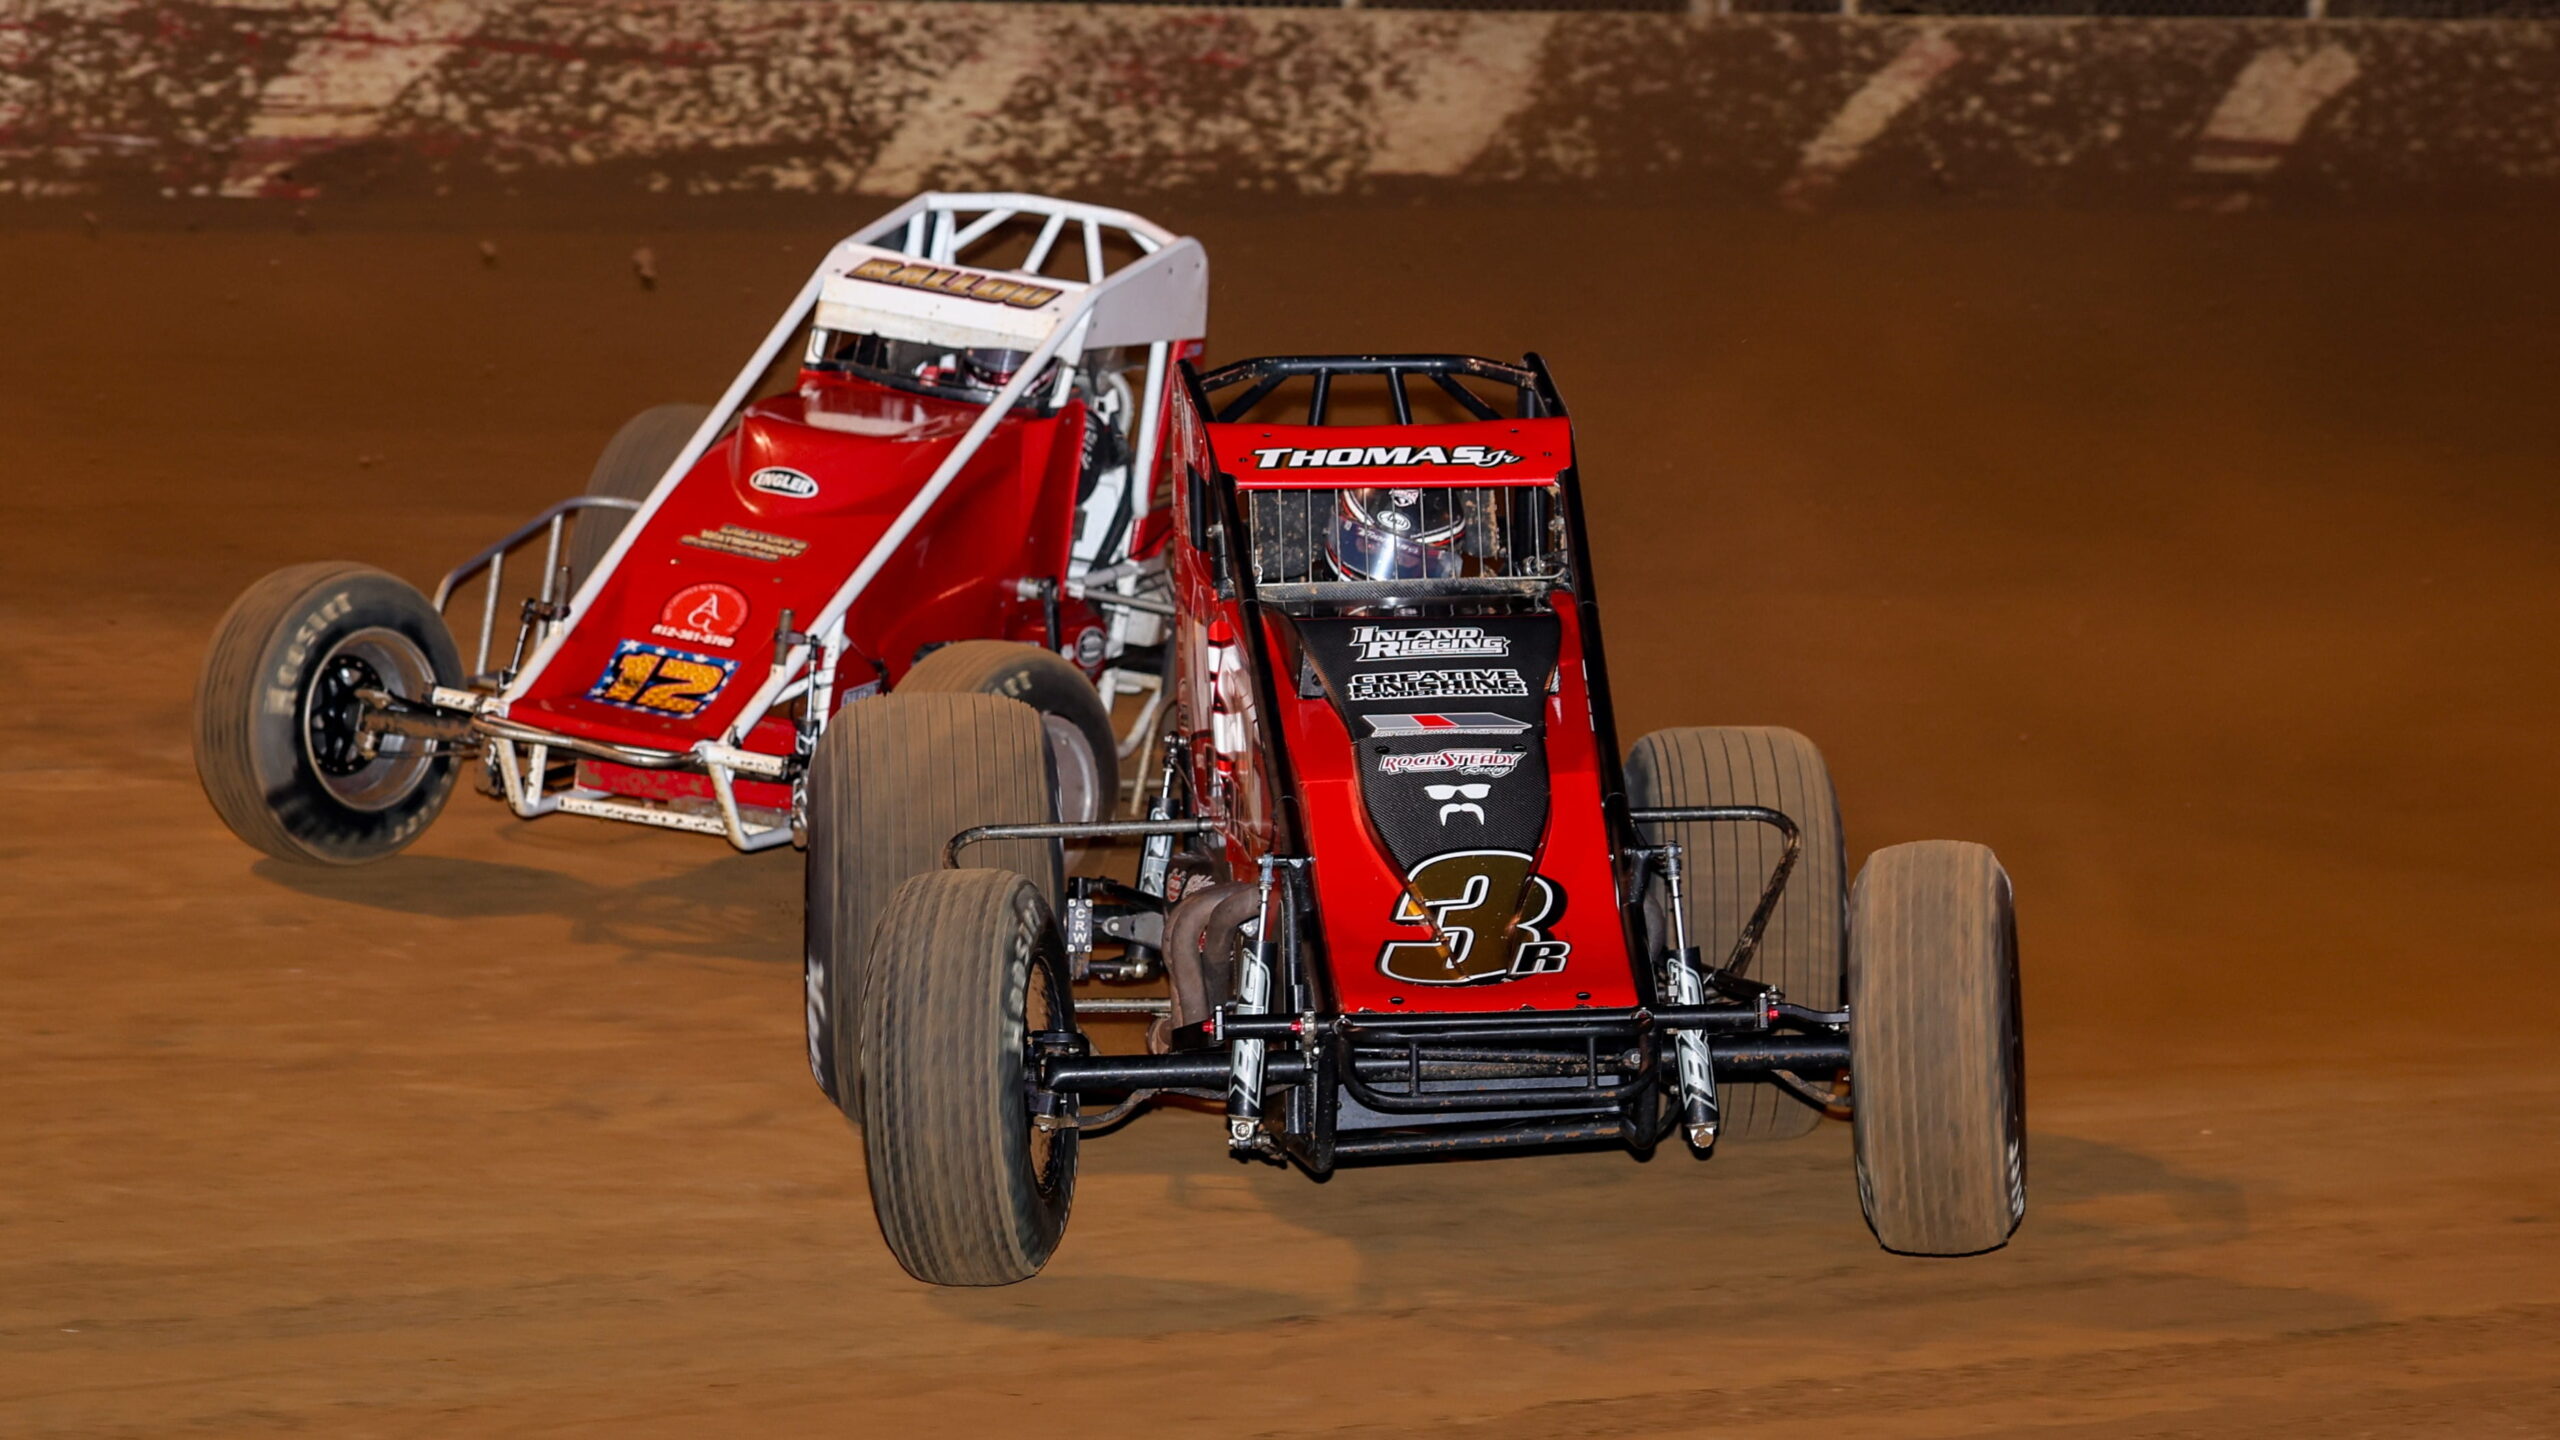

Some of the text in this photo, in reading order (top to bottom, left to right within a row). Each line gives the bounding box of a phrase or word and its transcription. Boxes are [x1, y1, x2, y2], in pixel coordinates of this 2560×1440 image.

[846, 257, 1063, 309] BALLOU
[1255, 446, 1485, 469] THOMAS
[756, 472, 812, 494] ENGLER
[1353, 626, 1482, 643] INLAND
[1363, 637, 1507, 659] RIGGING
[601, 651, 726, 714] 12
[1351, 680, 1526, 694] FINISHING
[1353, 670, 1518, 685] CREATIVE
[1353, 688, 1525, 699] POWDER COATING
[1073, 907, 1088, 944] CRW
